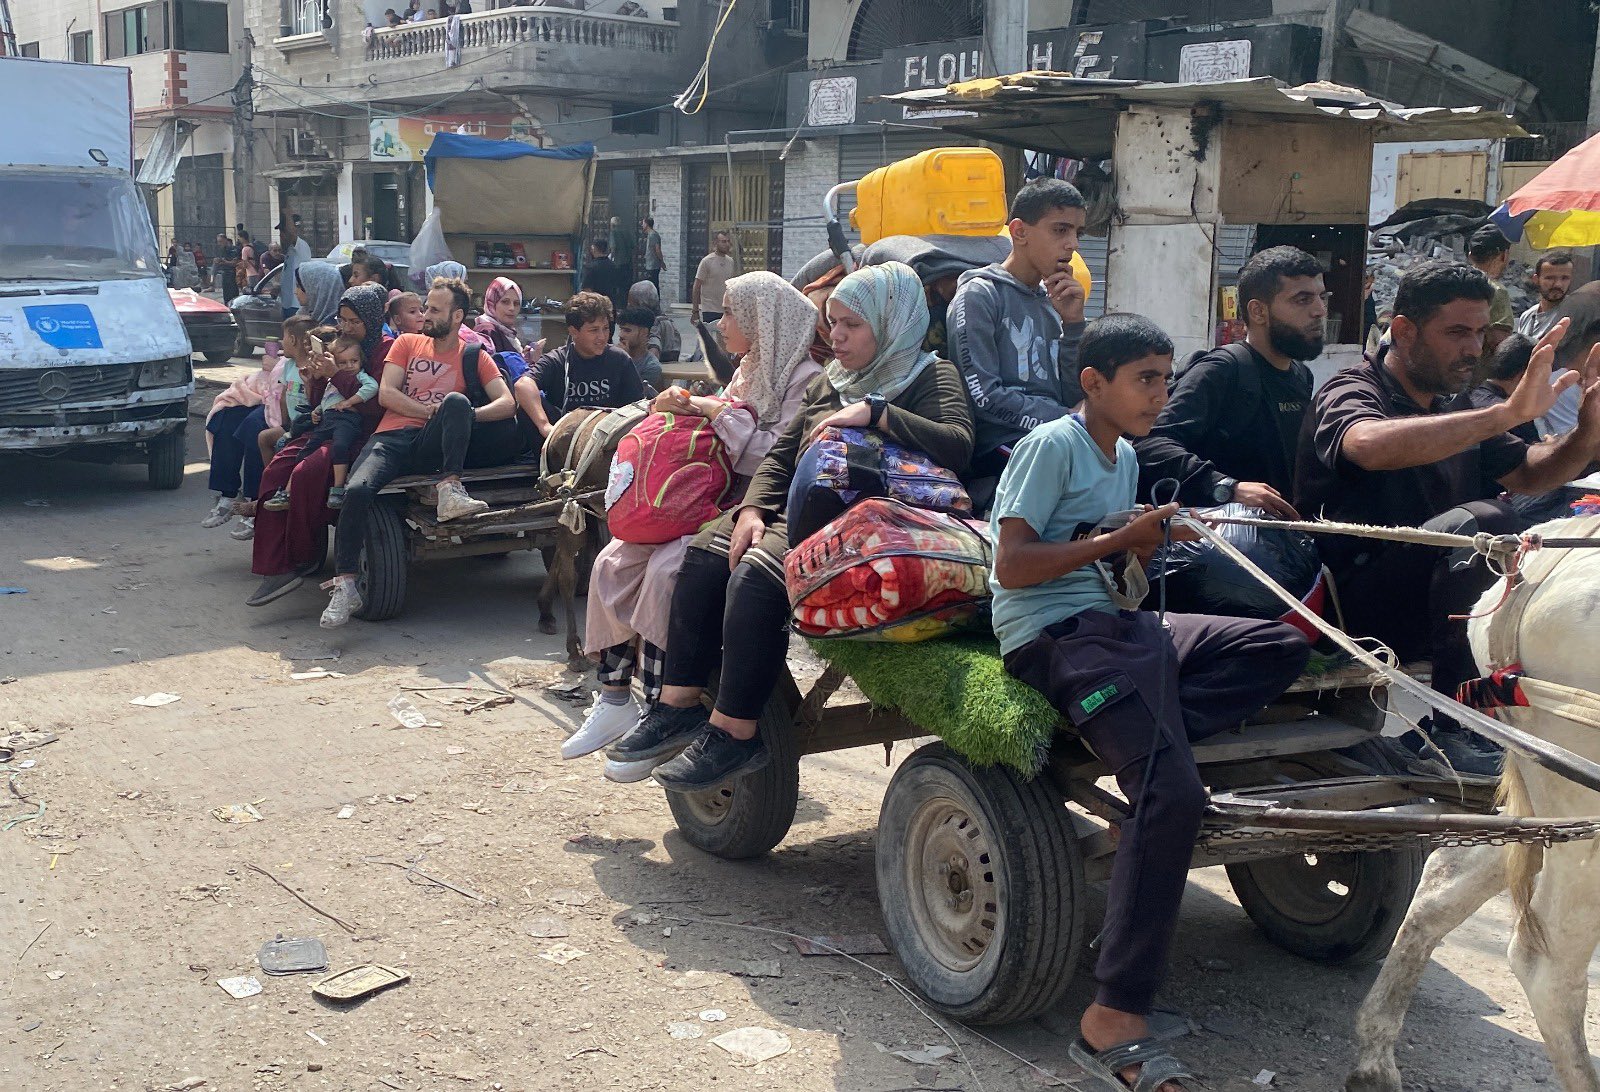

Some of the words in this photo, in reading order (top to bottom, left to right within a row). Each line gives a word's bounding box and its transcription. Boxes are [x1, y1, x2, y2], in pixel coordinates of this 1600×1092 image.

[904, 42, 1053, 88] FLOUH
[409, 357, 442, 376] LOV
[566, 379, 610, 397] BOSS
[965, 374, 989, 408] START
